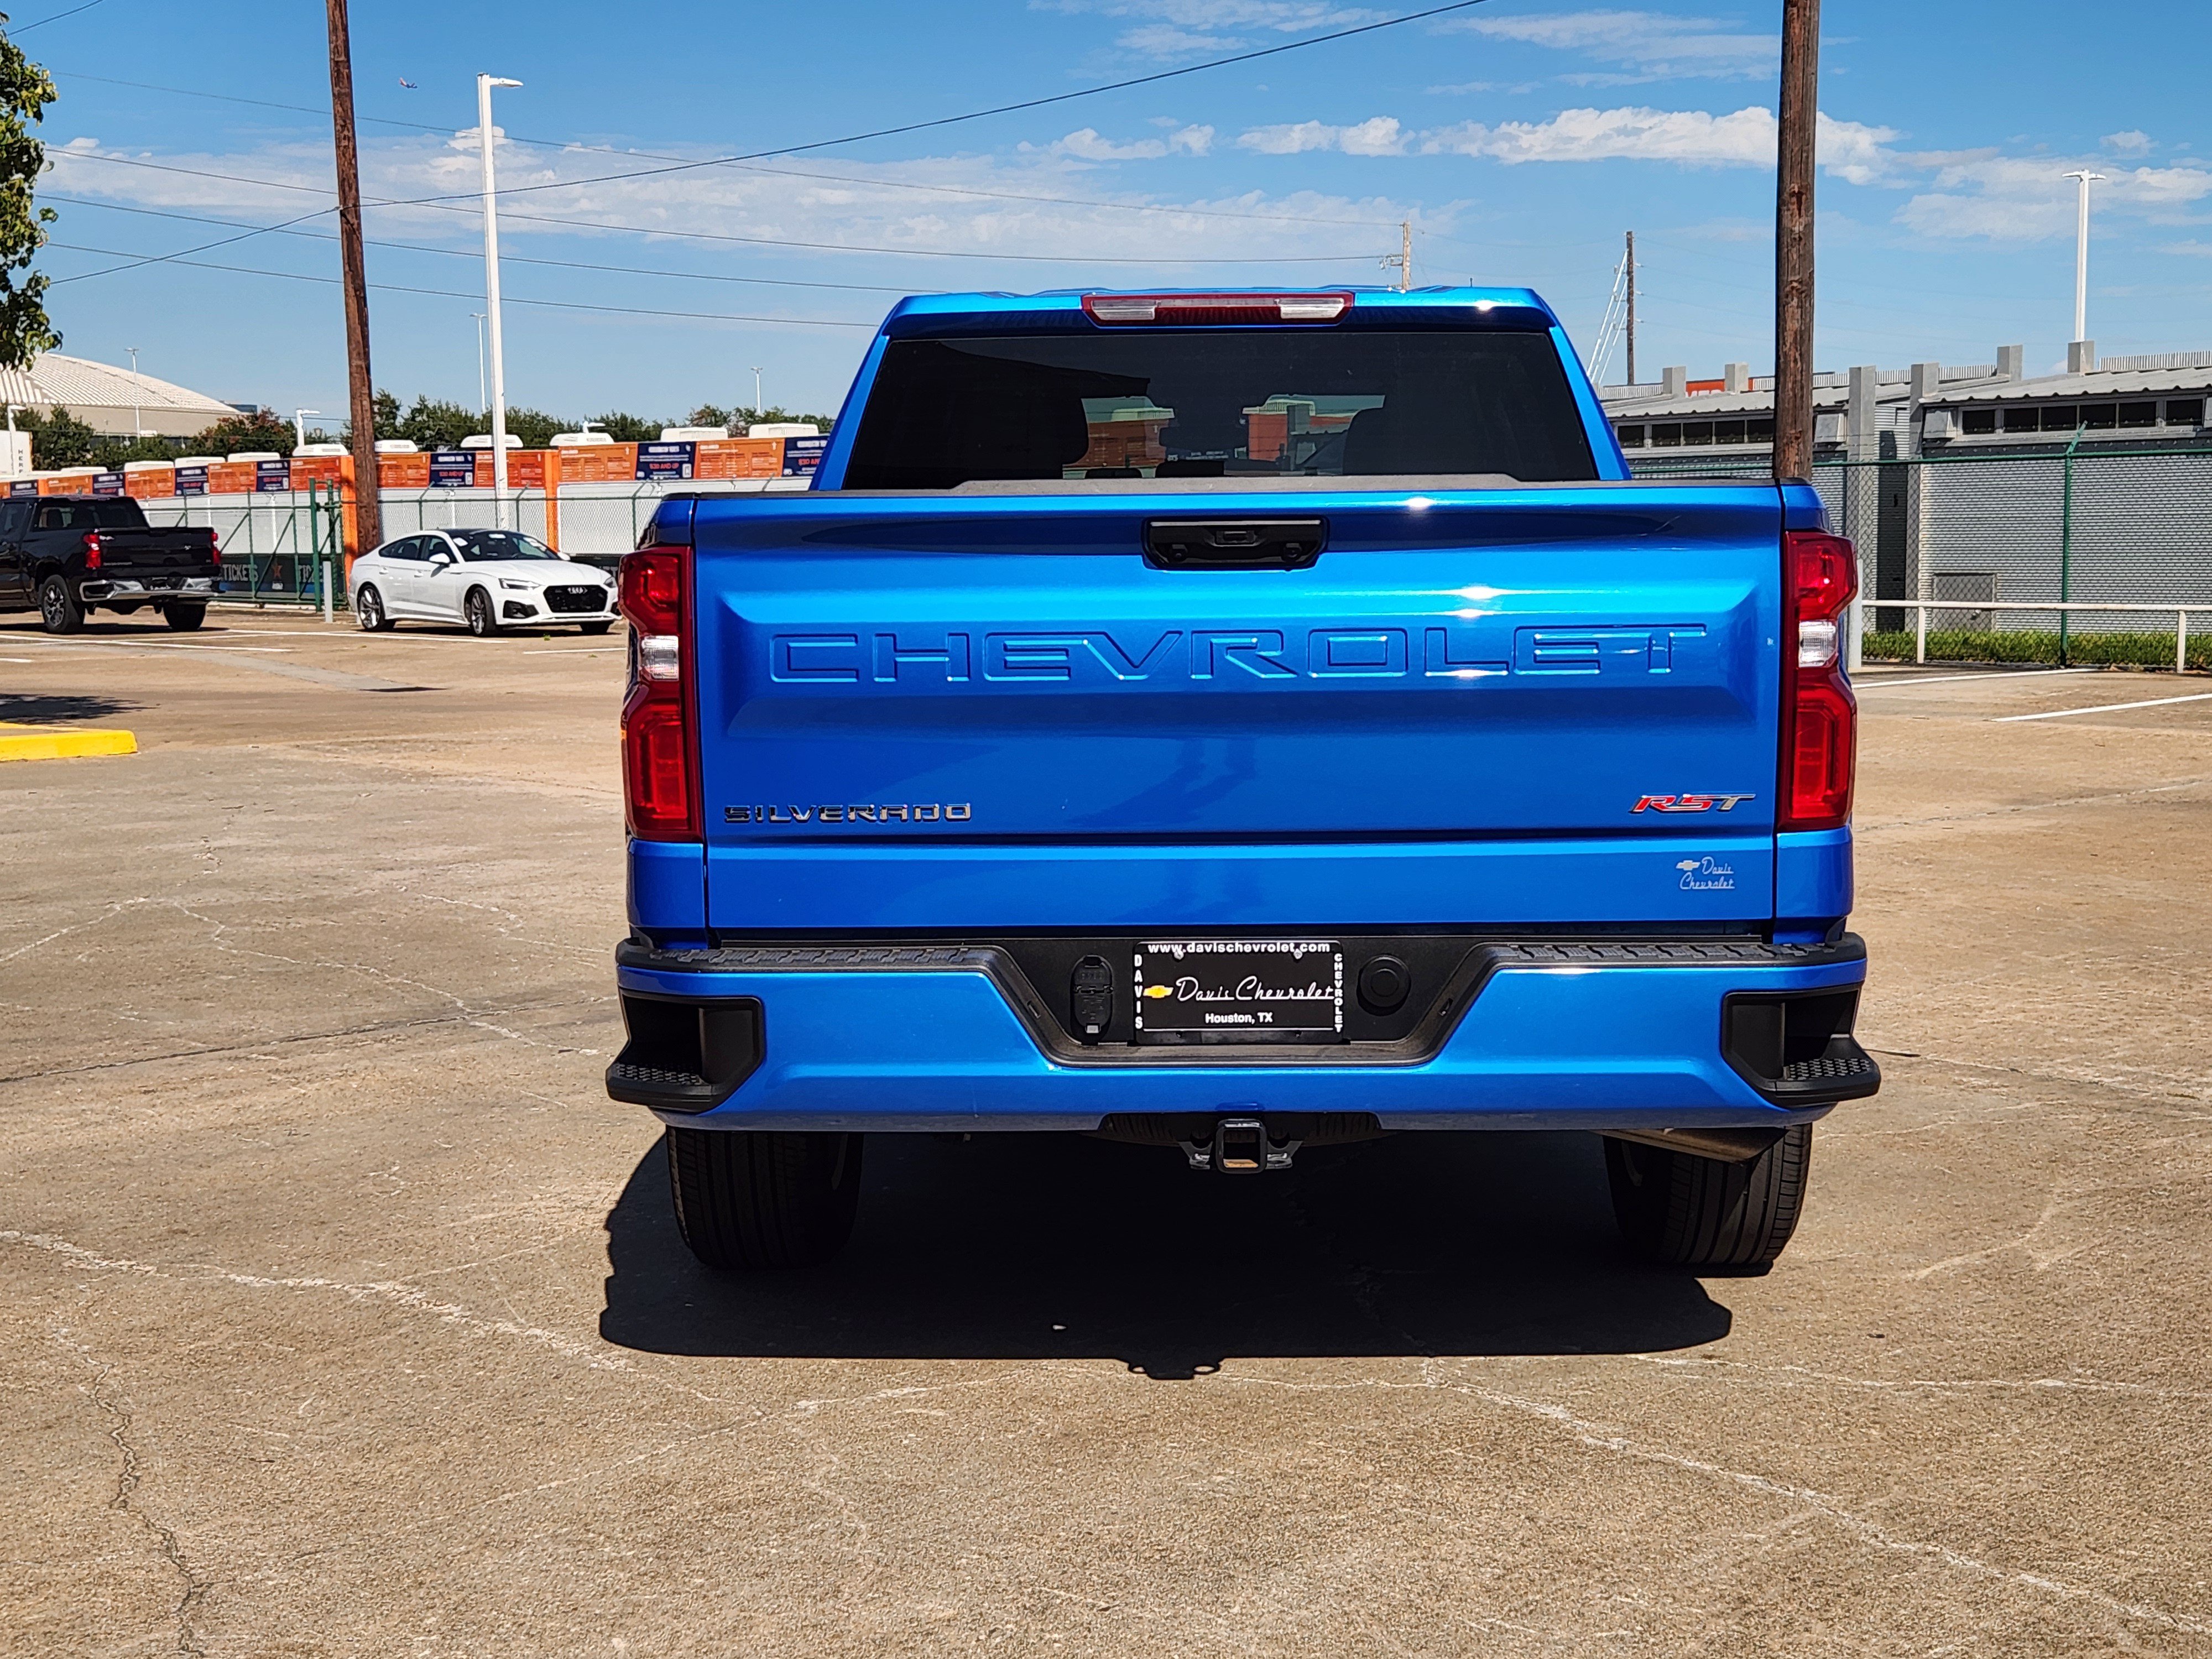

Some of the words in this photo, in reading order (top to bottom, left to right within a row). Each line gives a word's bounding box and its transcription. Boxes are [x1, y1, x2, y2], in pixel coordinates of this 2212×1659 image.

[769, 623, 1707, 683] CHEVROLET
[724, 803, 971, 823] SILVERADO
[1629, 794, 1756, 813] RST
[1702, 857, 1734, 874] Davis
[1679, 872, 1735, 889] Chevrolet
[1147, 942, 1330, 953] www.davischevrolet.com
[1134, 954, 1143, 1029] DAVIS
[1176, 977, 1234, 1001] Davis
[1235, 975, 1334, 1000] Chevrolet
[1334, 953, 1343, 1033] CHEVROLET
[1205, 1013, 1255, 1024] Houston,
[1257, 1012, 1273, 1022] TX
